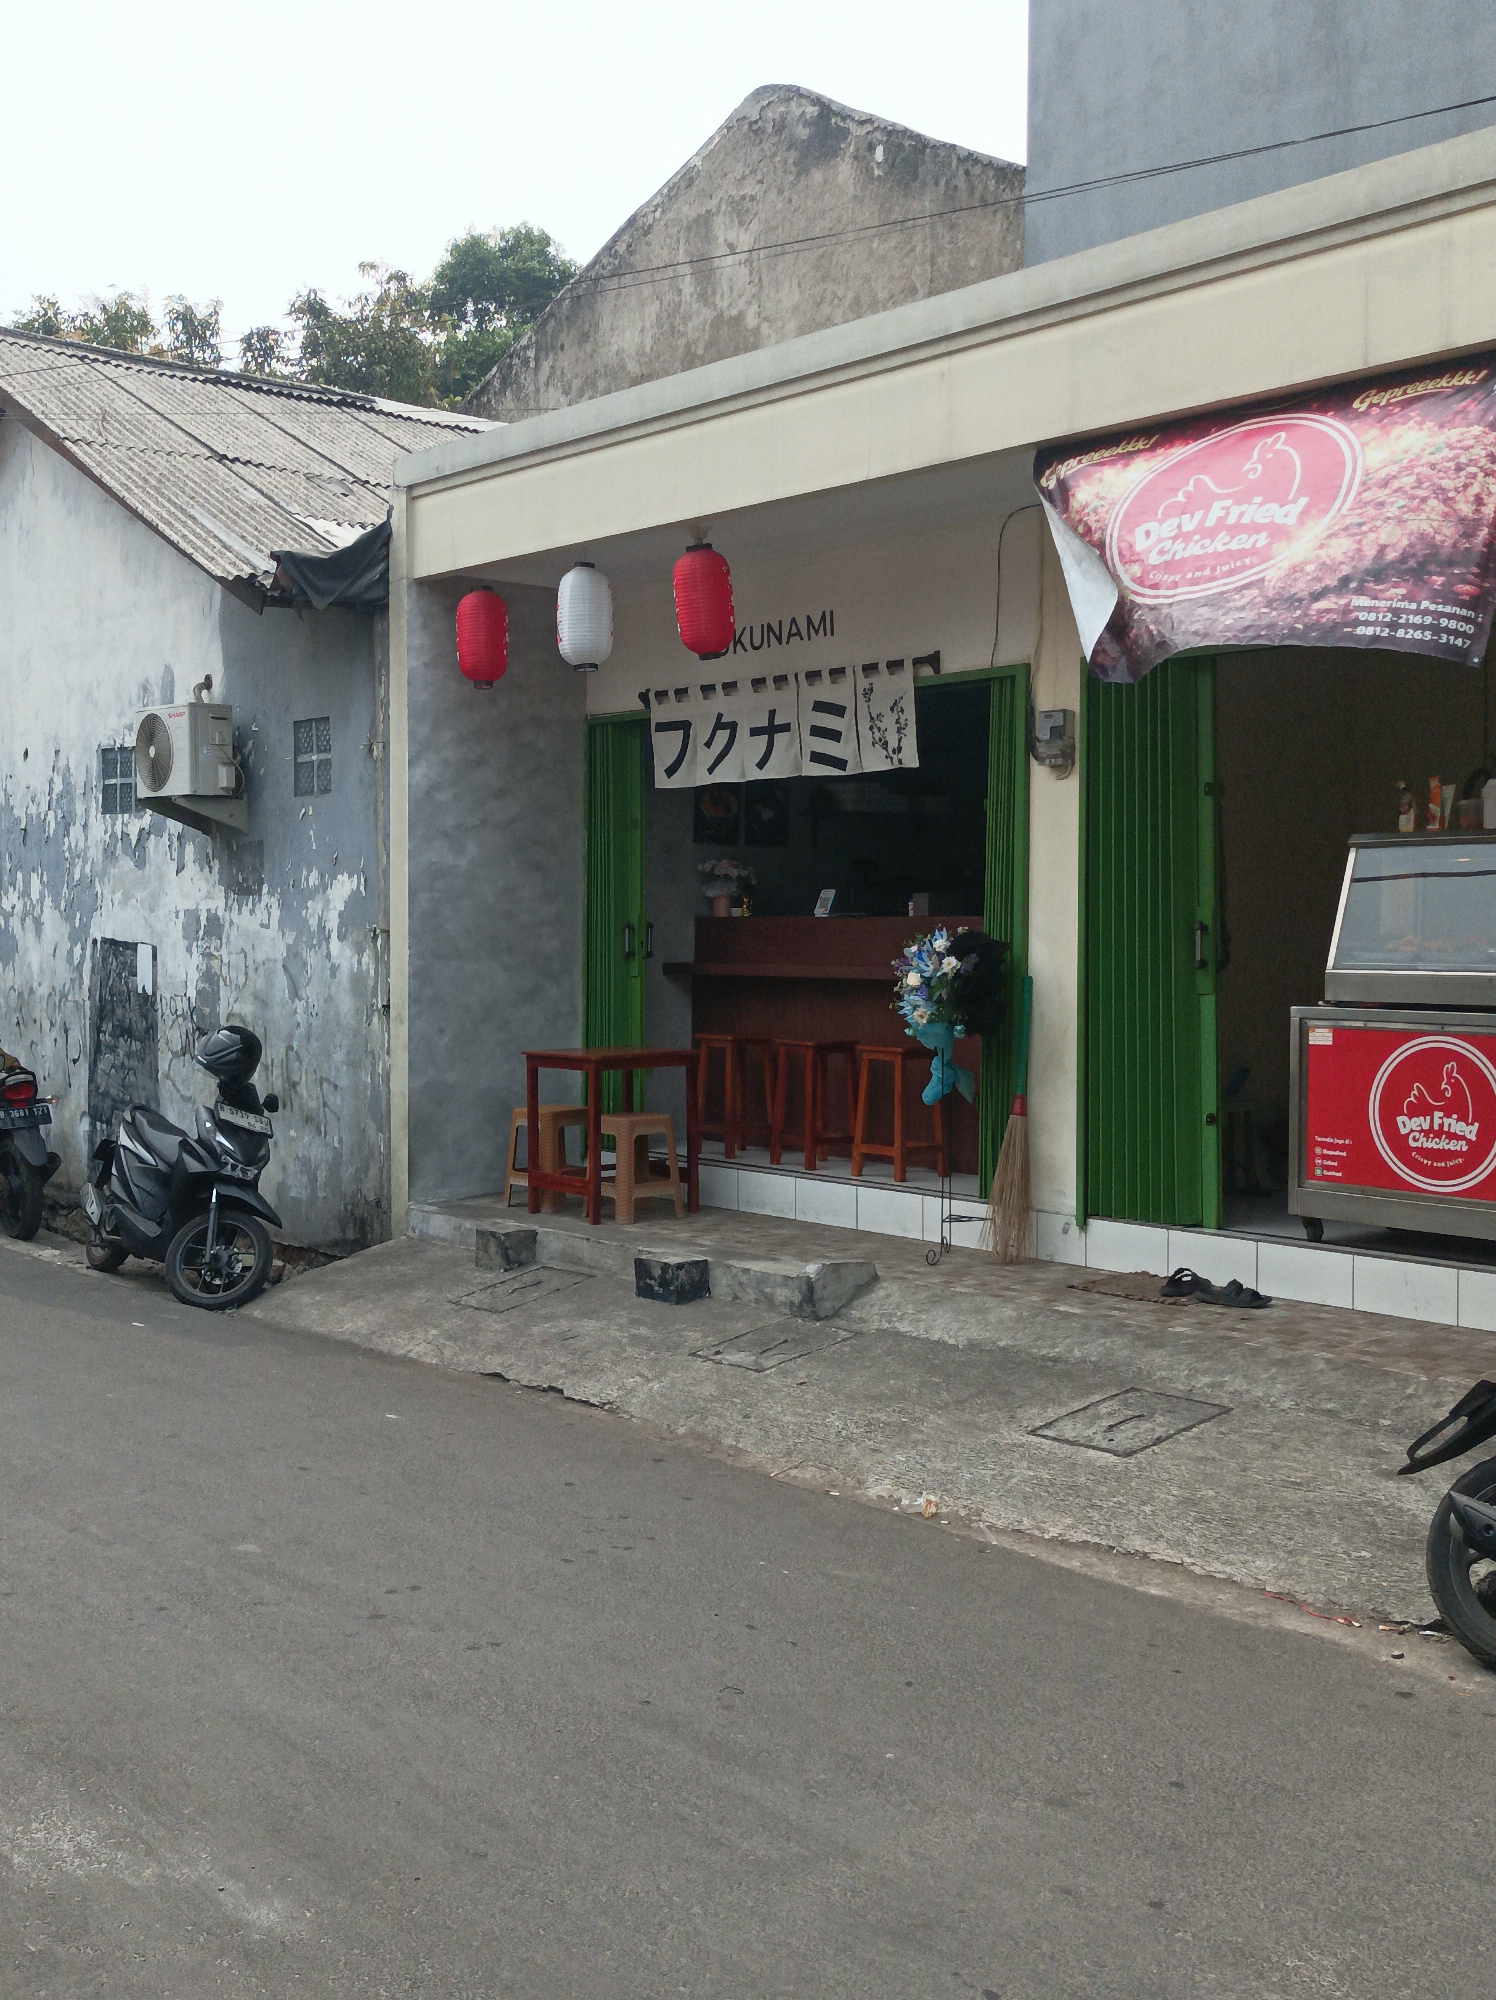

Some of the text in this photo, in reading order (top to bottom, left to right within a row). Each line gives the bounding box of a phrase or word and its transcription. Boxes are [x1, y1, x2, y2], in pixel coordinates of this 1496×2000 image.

[1134, 496, 1311, 552] Dev Fried
[1147, 530, 1271, 566] Chicken
[1185, 566, 1210, 579] and
[1350, 596, 1418, 611] Menerima
[1420, 600, 1476, 620] Pesanan
[1358, 611, 1476, 635] 0812-2169-9800
[1355, 625, 1472, 650] 0812-8265-3147
[654, 699, 850, 781] フクナミ
[1395, 1110, 1480, 1142] Dev Fried
[1408, 1131, 1469, 1152] Chicken
